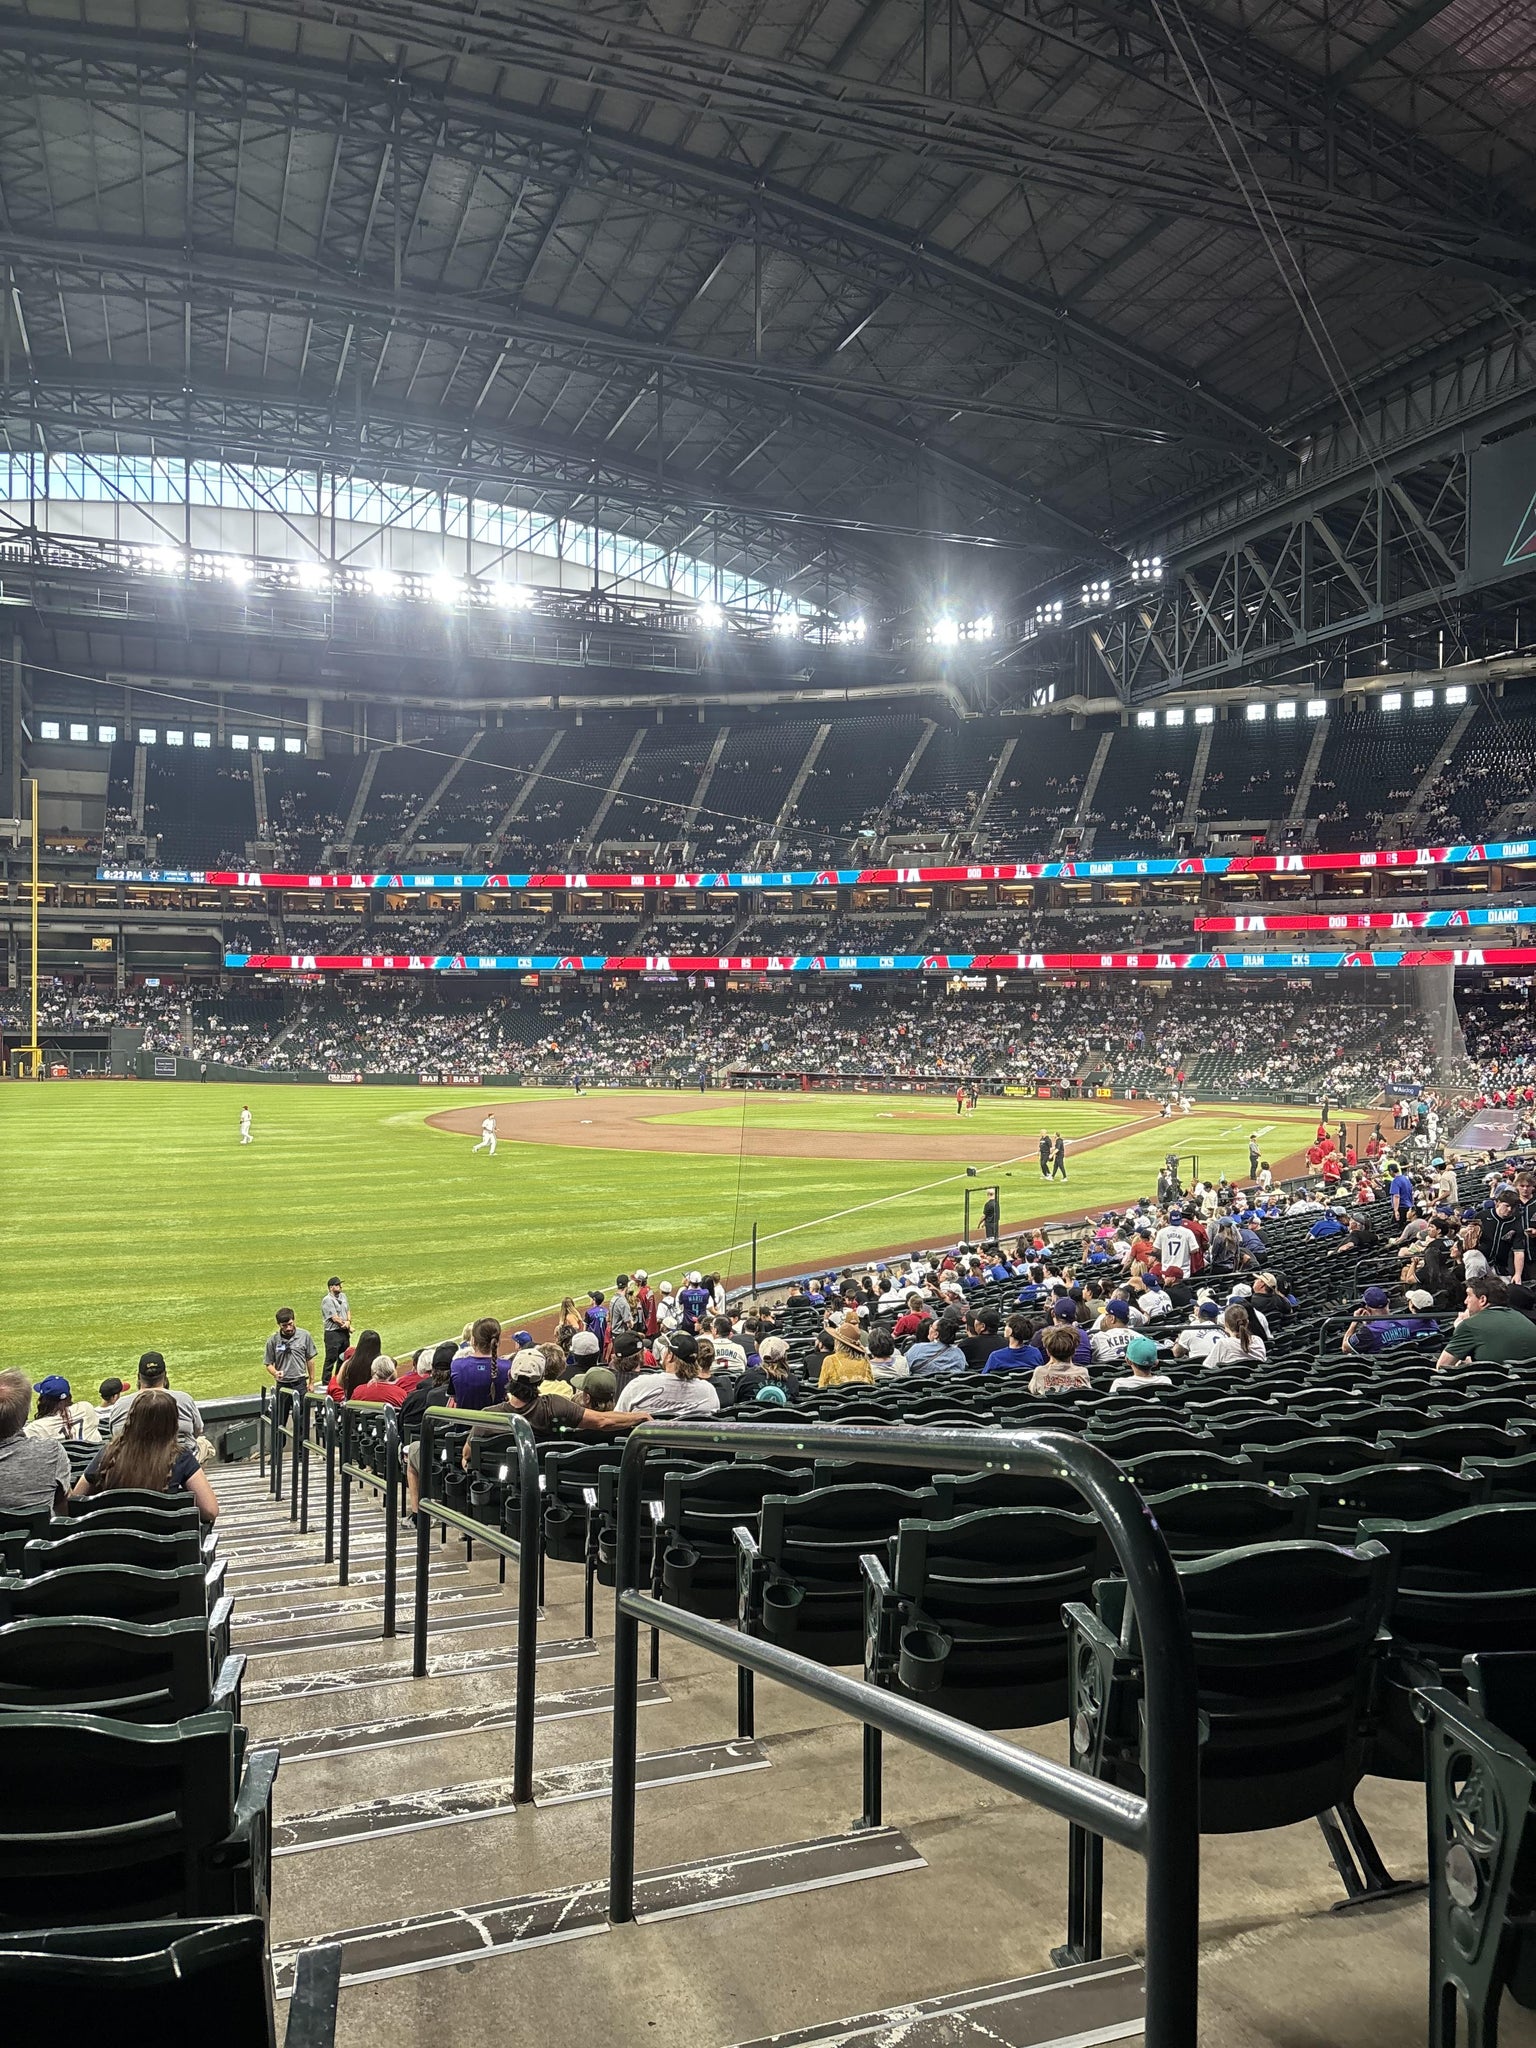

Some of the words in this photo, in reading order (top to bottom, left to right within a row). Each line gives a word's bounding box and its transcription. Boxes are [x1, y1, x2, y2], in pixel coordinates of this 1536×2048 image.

[103, 871, 124, 880] 6:22
[126, 871, 143, 880] PM
[422, 1075, 448, 1083] BARS
[453, 1075, 480, 1083] BAR-S
[1168, 1241, 1181, 1256] 17
[1381, 1327, 1410, 1344] JOHNSON
